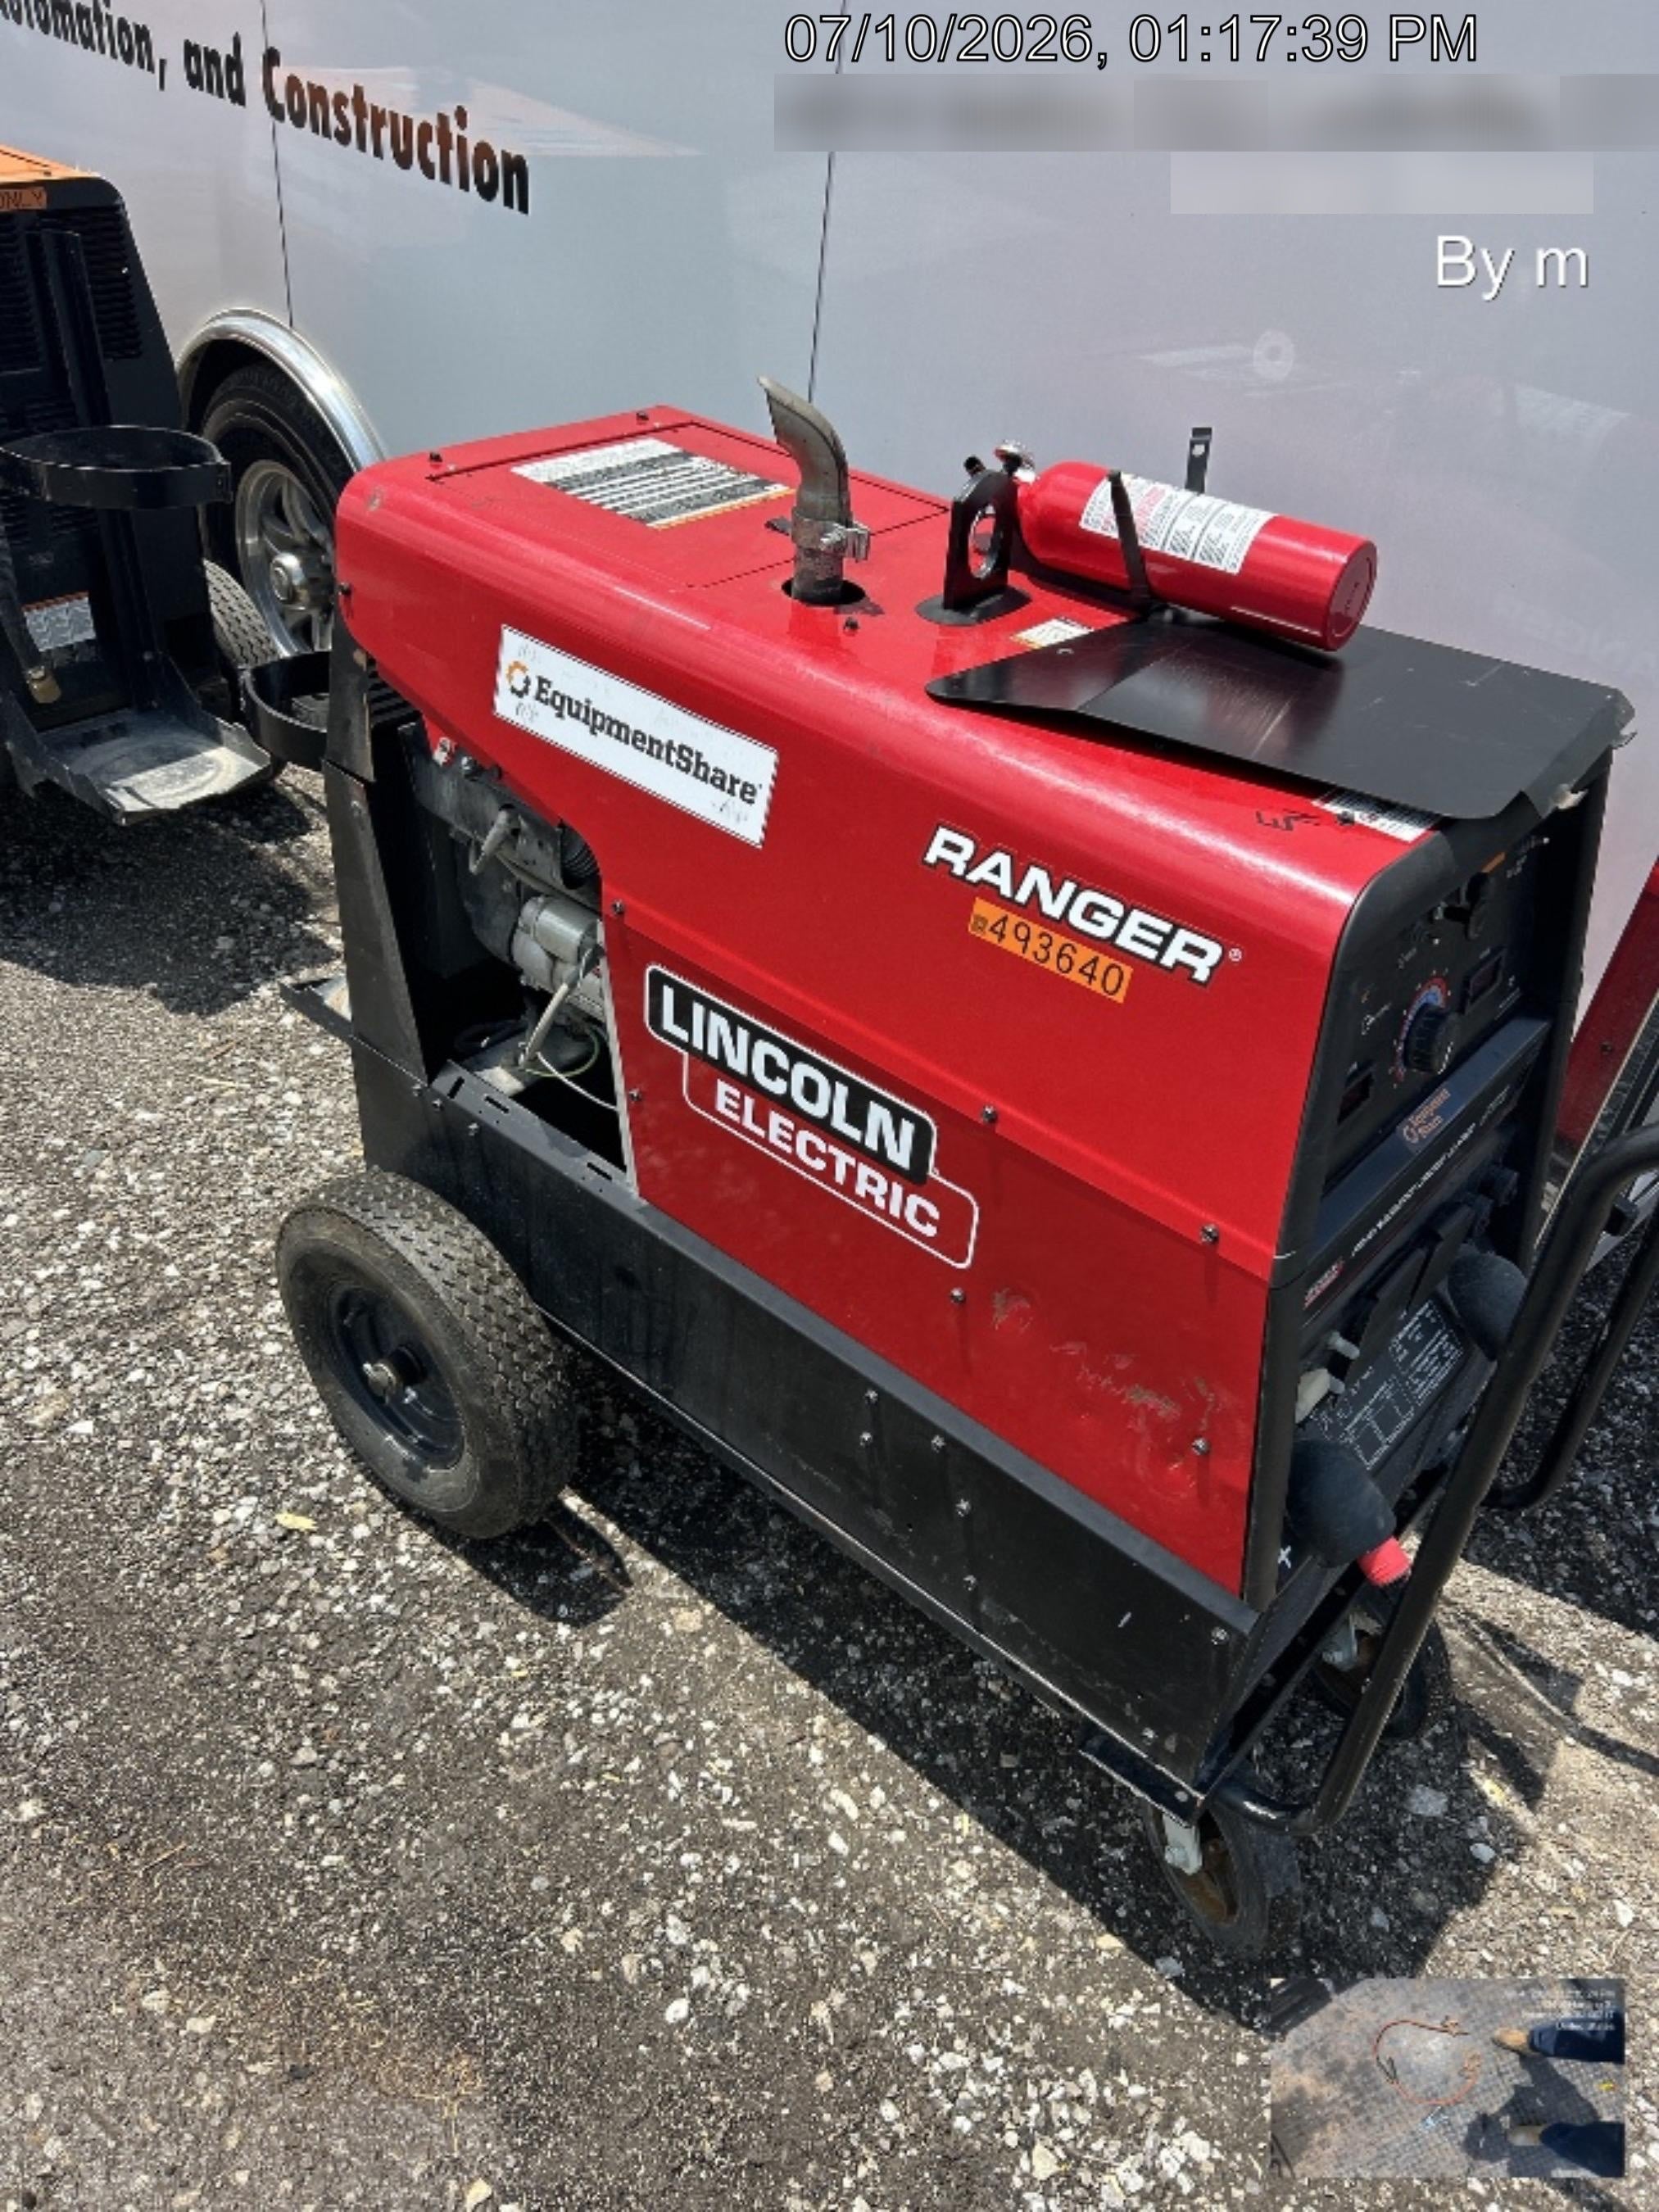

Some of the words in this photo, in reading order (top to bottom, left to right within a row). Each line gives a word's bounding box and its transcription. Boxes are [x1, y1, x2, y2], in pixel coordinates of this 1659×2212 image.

[184, 33, 247, 107] and
[262, 47, 529, 215] Construction
[535, 675, 758, 805] EquipmentShare
[989, 914, 1125, 996] 493640
[661, 983, 916, 1171] LINCOLN
[714, 1078, 941, 1237] ELECTRIC
